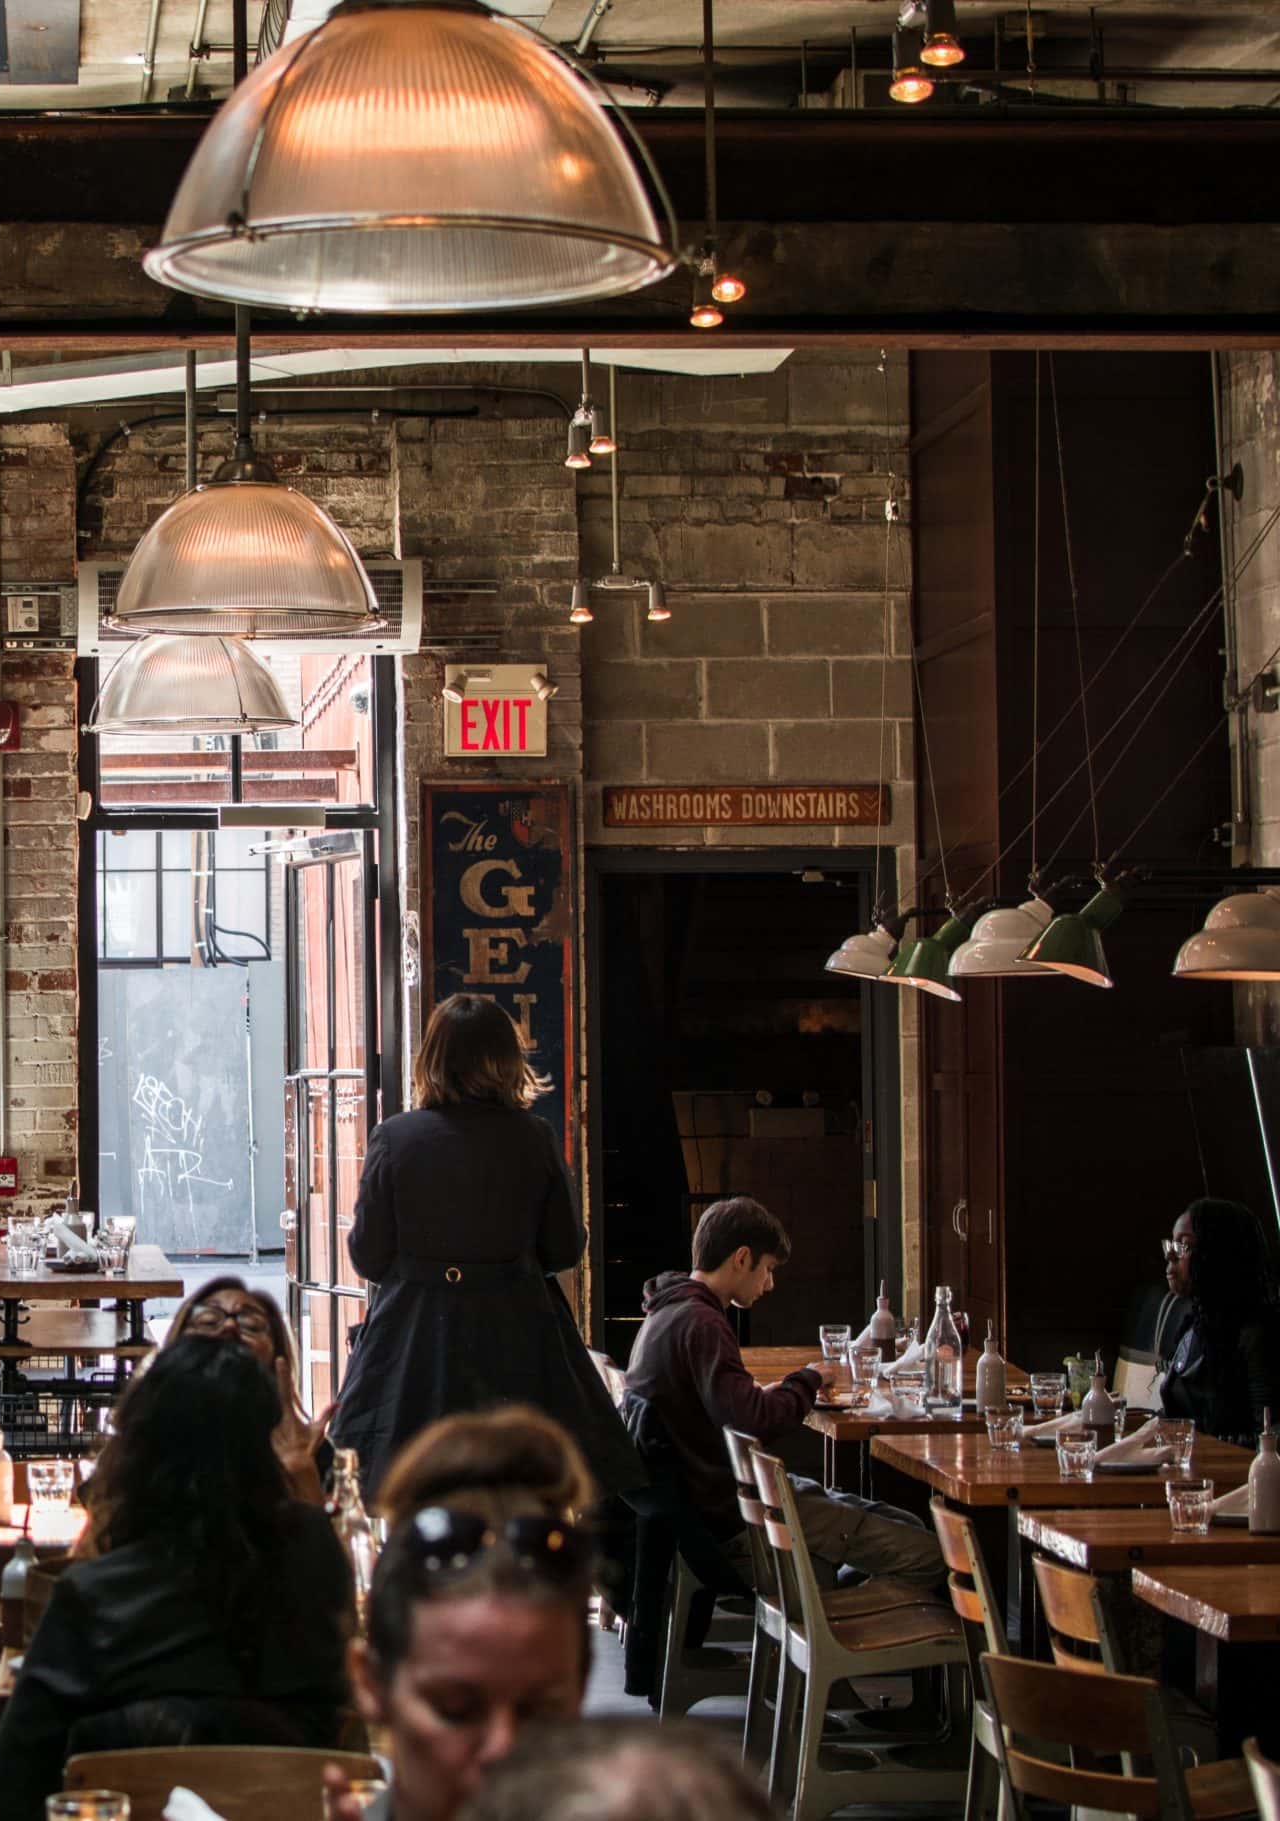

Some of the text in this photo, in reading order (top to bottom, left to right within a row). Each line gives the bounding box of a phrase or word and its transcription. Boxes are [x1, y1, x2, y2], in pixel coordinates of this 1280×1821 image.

[461, 699, 531, 750] EXIT
[613, 792, 860, 820] WASHROOMS DOWNSTAIRS
[440, 810, 498, 852] The
